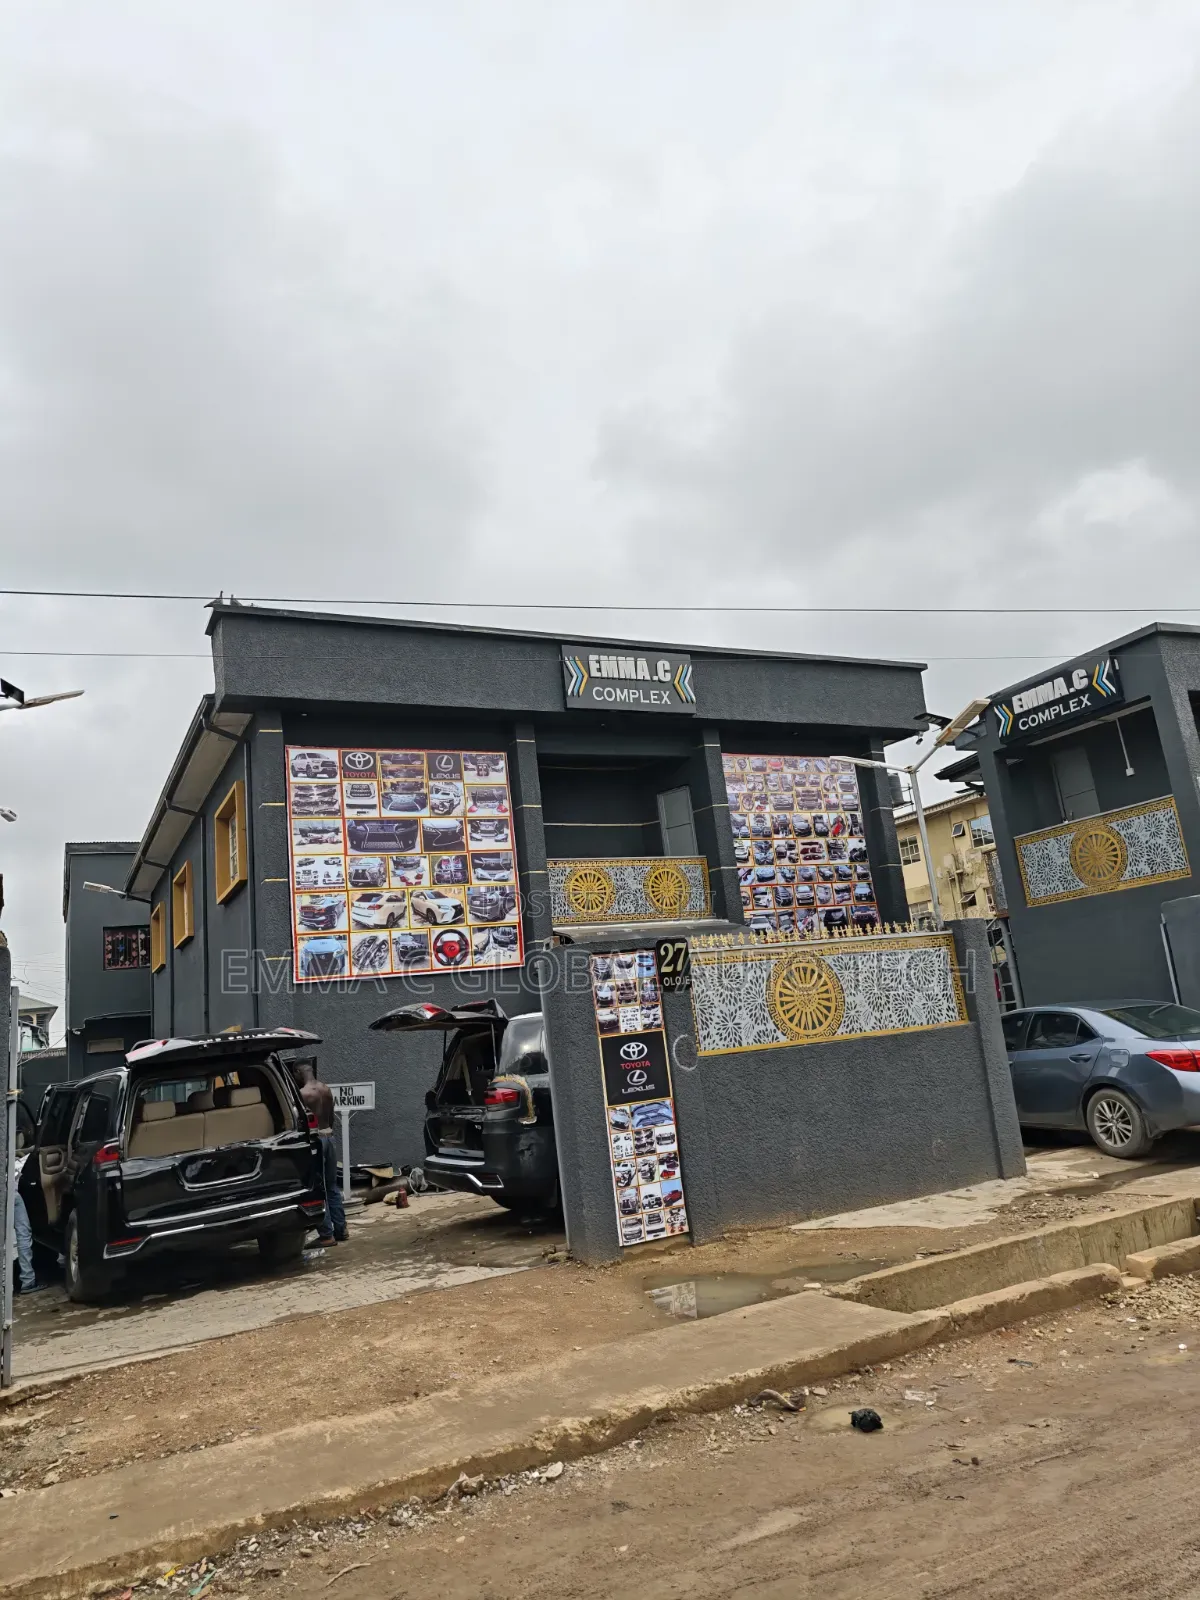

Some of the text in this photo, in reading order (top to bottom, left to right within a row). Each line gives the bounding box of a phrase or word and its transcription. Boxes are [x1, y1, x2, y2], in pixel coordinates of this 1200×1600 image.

[588, 654, 671, 682] EMMA.C
[592, 686, 671, 705] COMPLEX
[1011, 668, 1089, 714] EMMA.C
[1018, 693, 1092, 731] COMPLEX
[344, 771, 376, 779] TOYOTA
[660, 942, 687, 973] 27
[620, 1060, 651, 1069] TOYOTA
[340, 1086, 354, 1097] NO
[621, 1084, 655, 1094] LEXUS
[333, 1095, 365, 1106] ARKING
